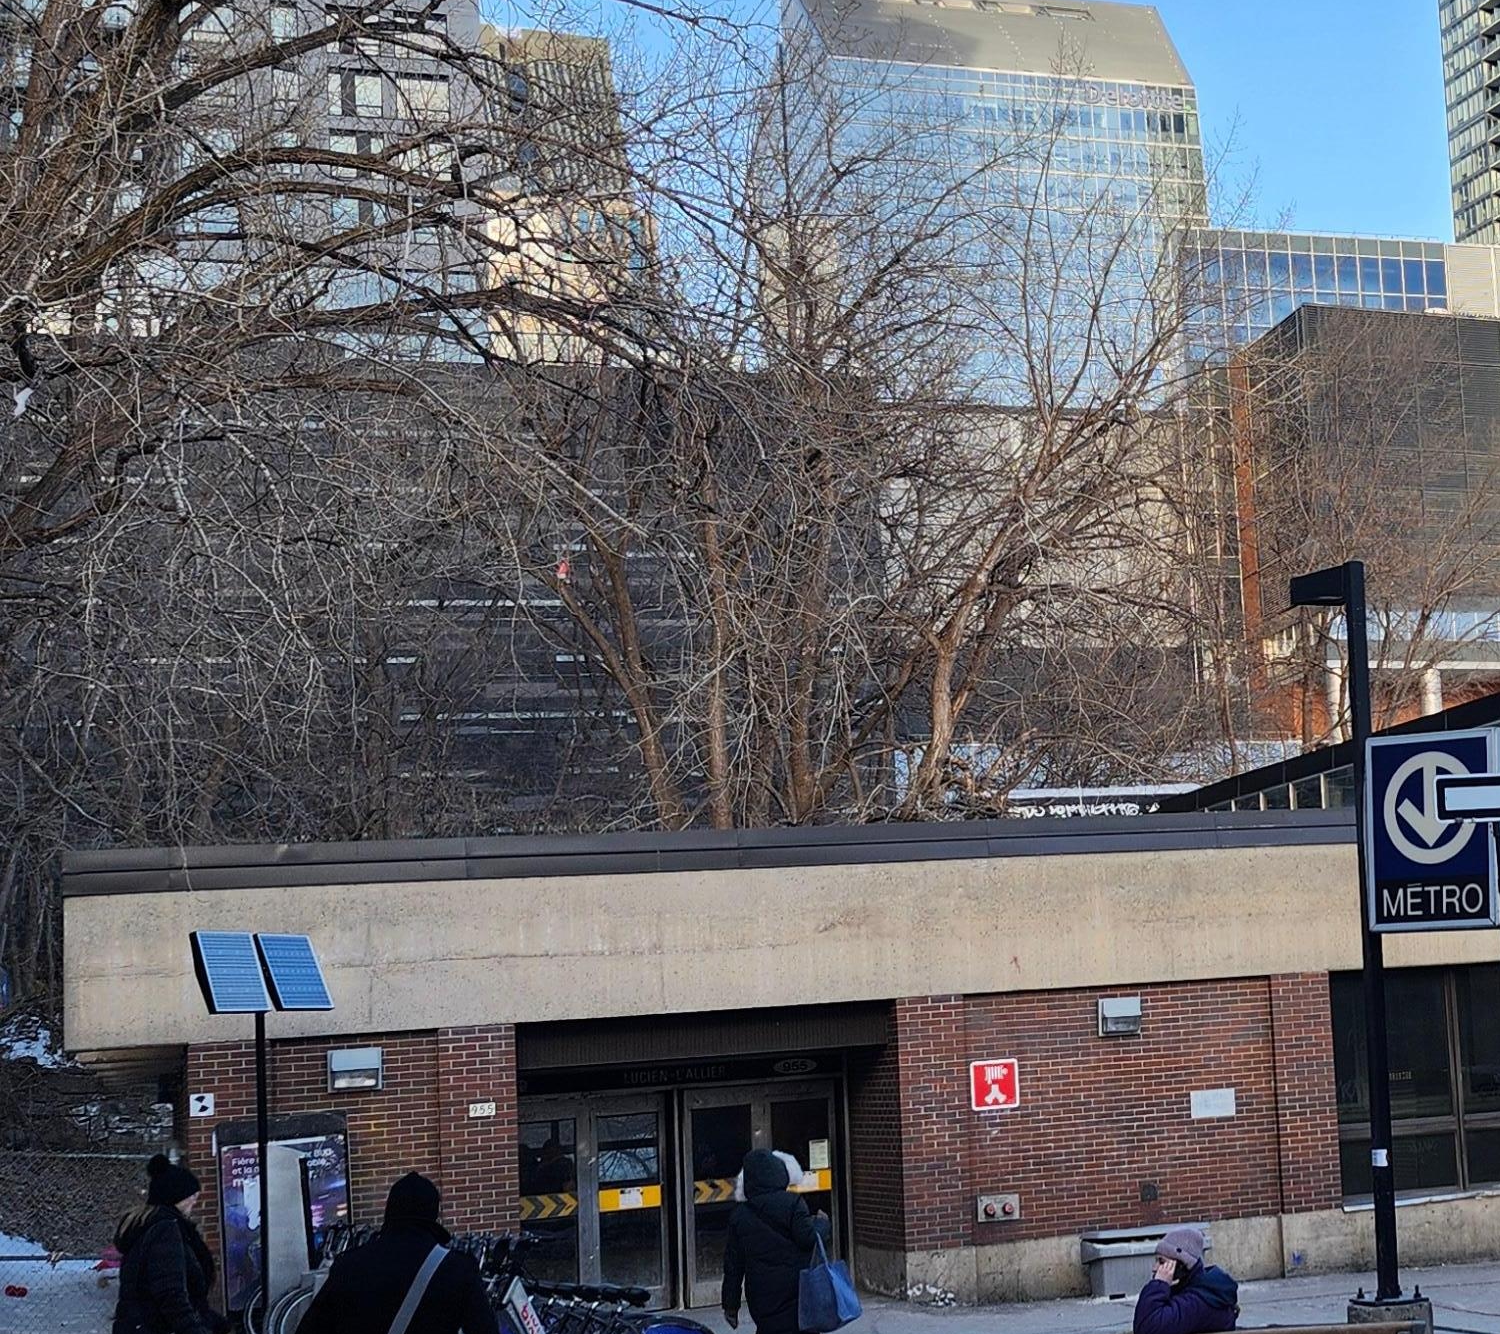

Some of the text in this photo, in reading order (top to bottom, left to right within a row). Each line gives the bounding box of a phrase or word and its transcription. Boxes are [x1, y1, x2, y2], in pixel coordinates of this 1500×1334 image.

[1382, 883, 1483, 917] MÉTRO
[782, 1060, 808, 1072] 955
[471, 1103, 494, 1115] 955
